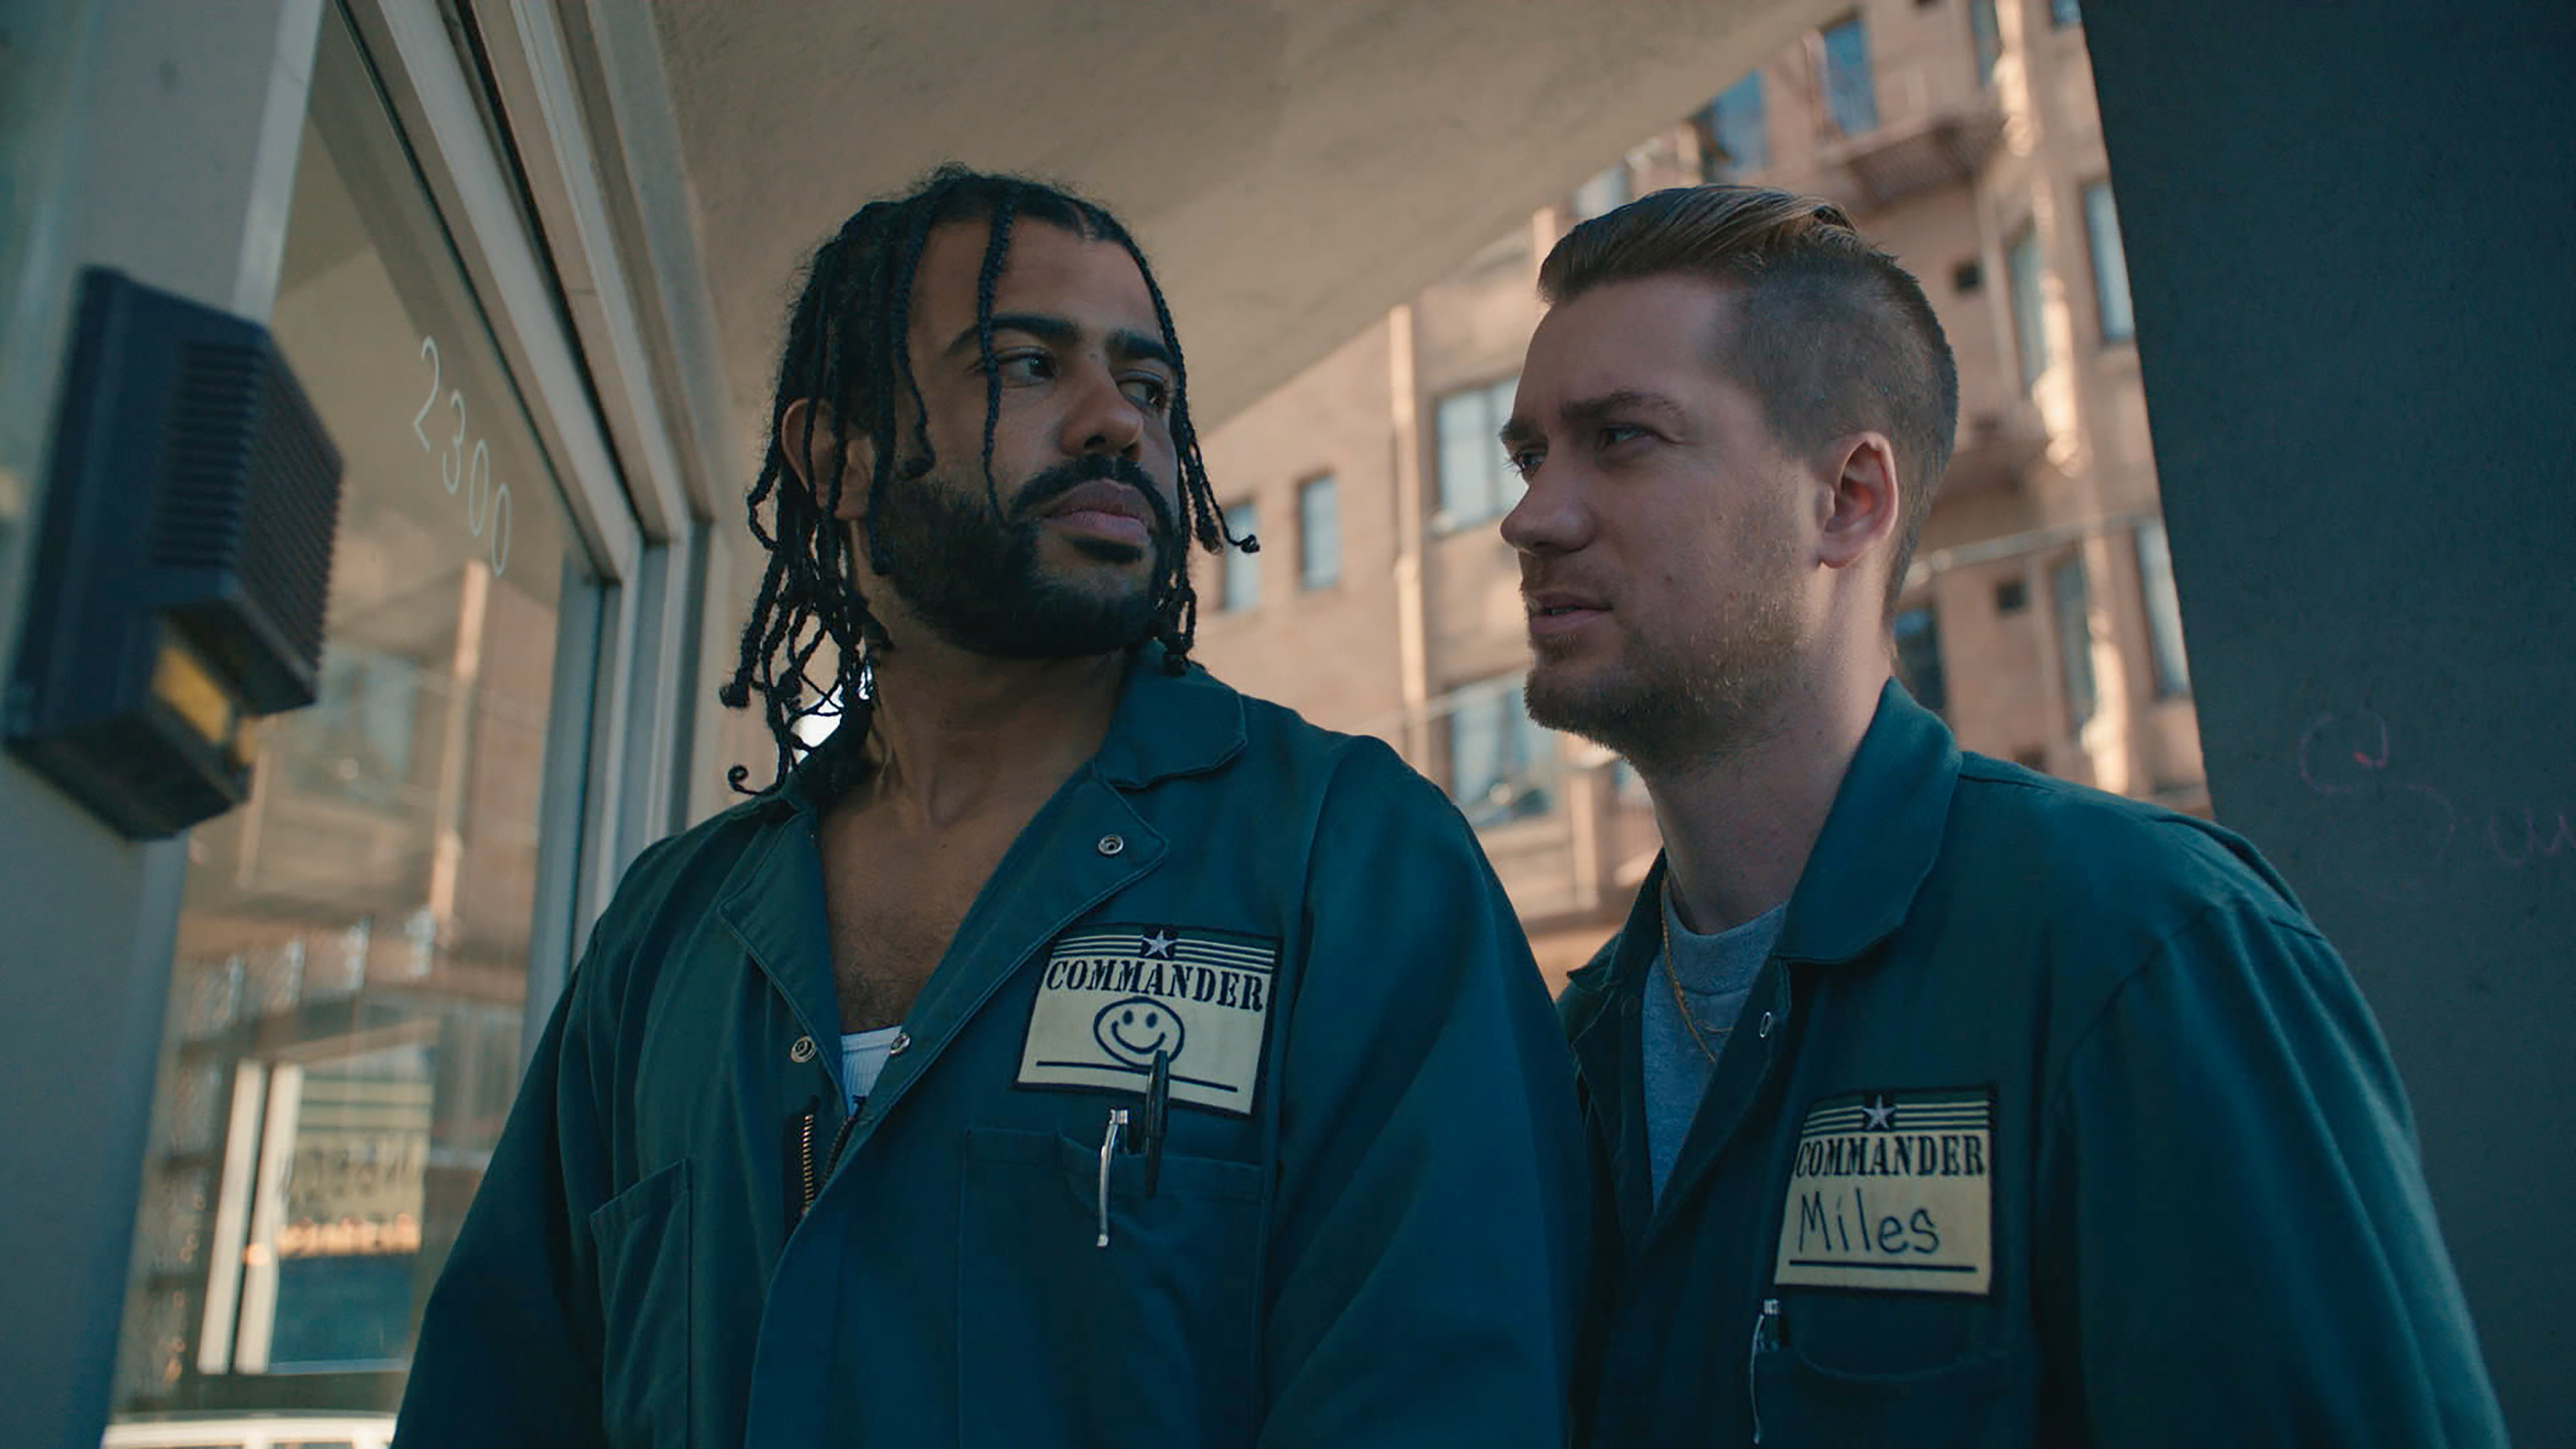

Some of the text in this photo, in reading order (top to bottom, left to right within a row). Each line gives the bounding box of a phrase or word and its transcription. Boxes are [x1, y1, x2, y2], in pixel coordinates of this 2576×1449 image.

[414, 334, 511, 576] 2300
[1045, 960, 1263, 1013] COMMANDER
[1796, 1135, 1985, 1178] COMMANDER
[1799, 1187, 1939, 1254] Miles
